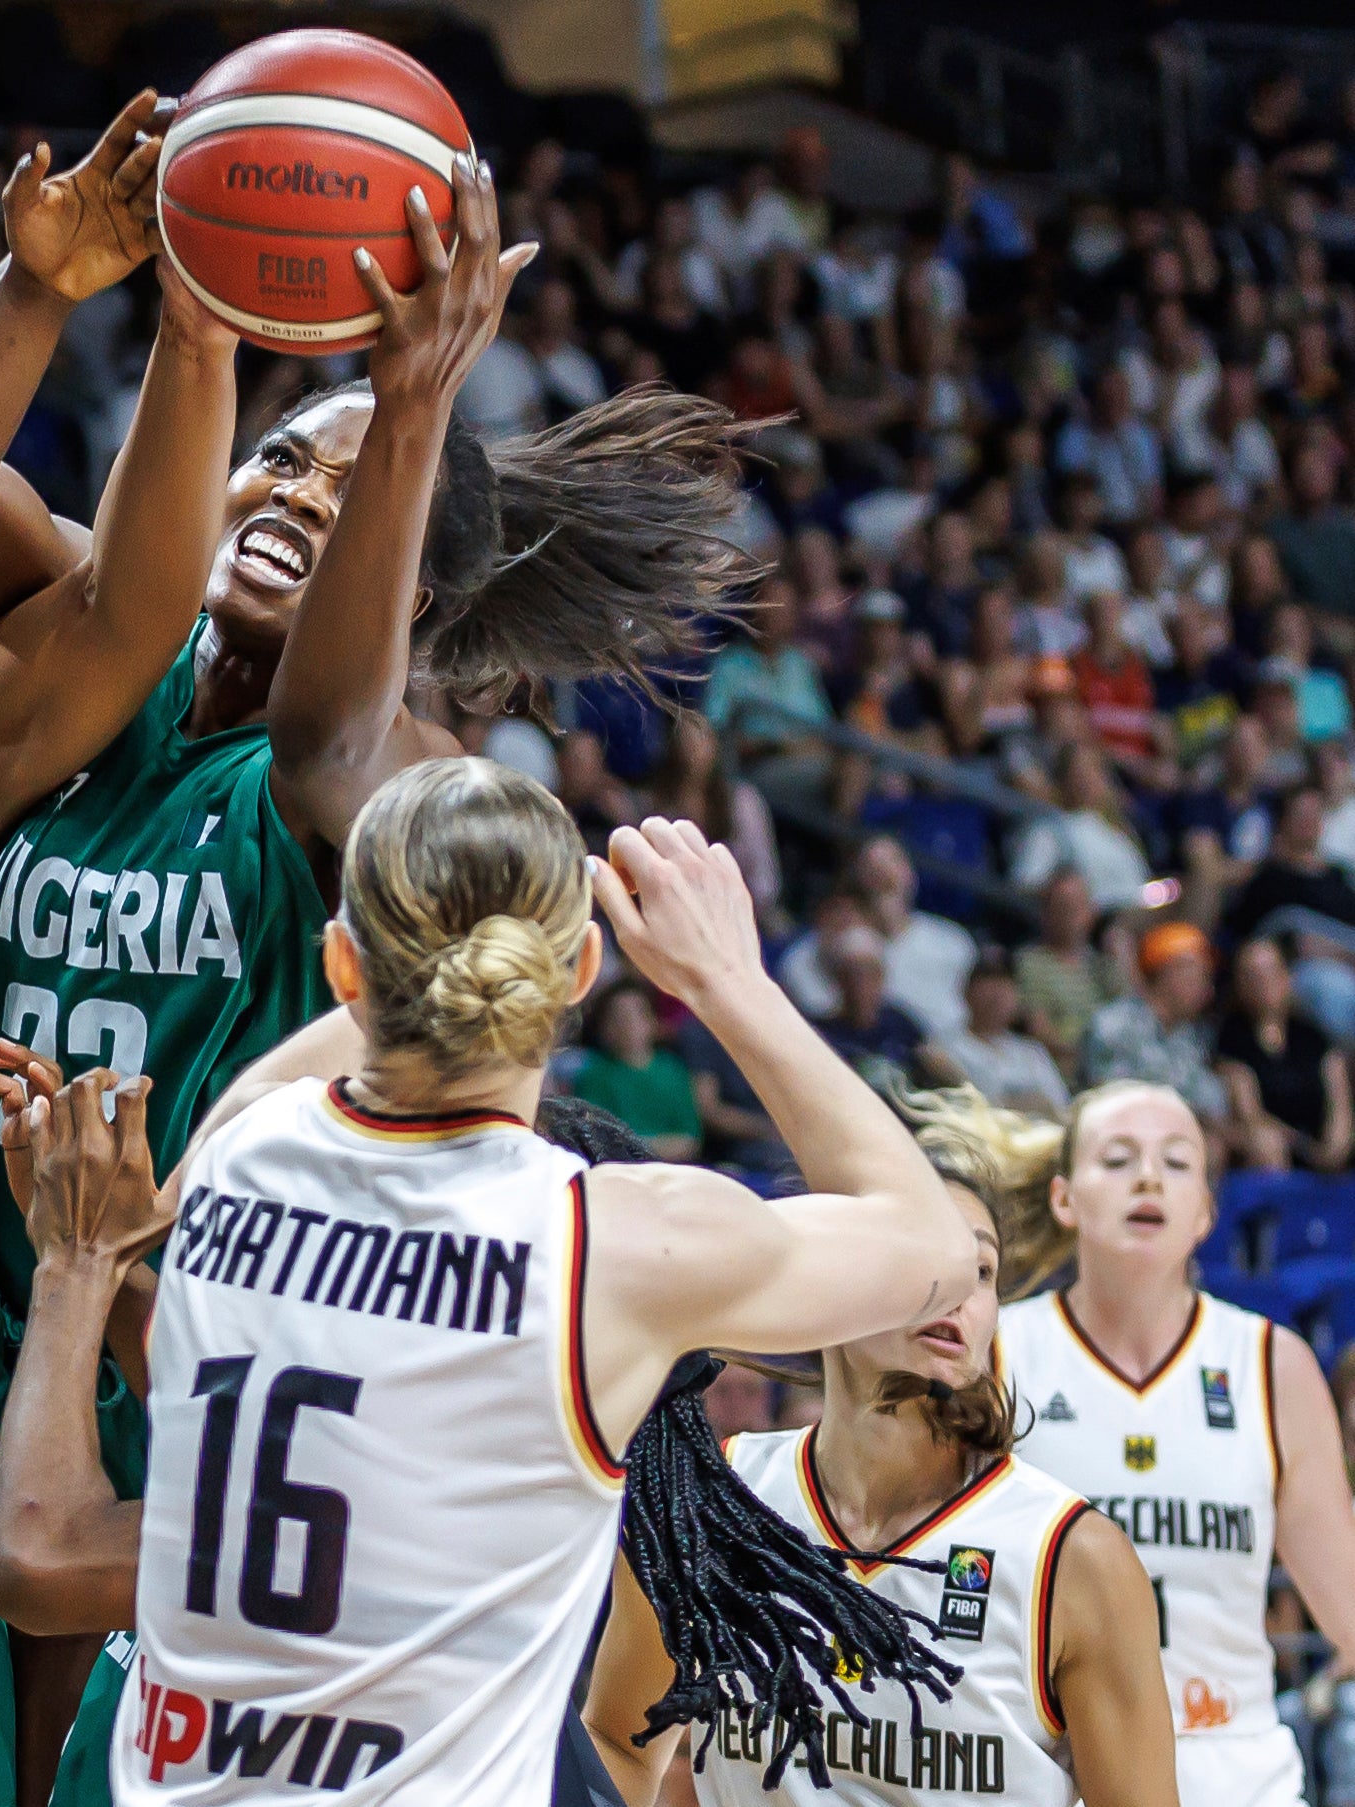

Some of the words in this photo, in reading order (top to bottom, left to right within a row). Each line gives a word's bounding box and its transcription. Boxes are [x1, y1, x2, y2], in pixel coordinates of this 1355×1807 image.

[228, 160, 369, 201] molten
[258, 253, 327, 285] FIBA
[176, 1184, 533, 1338] HARTMANN
[185, 1354, 364, 1636] 16
[947, 1597, 981, 1619] FIBA
